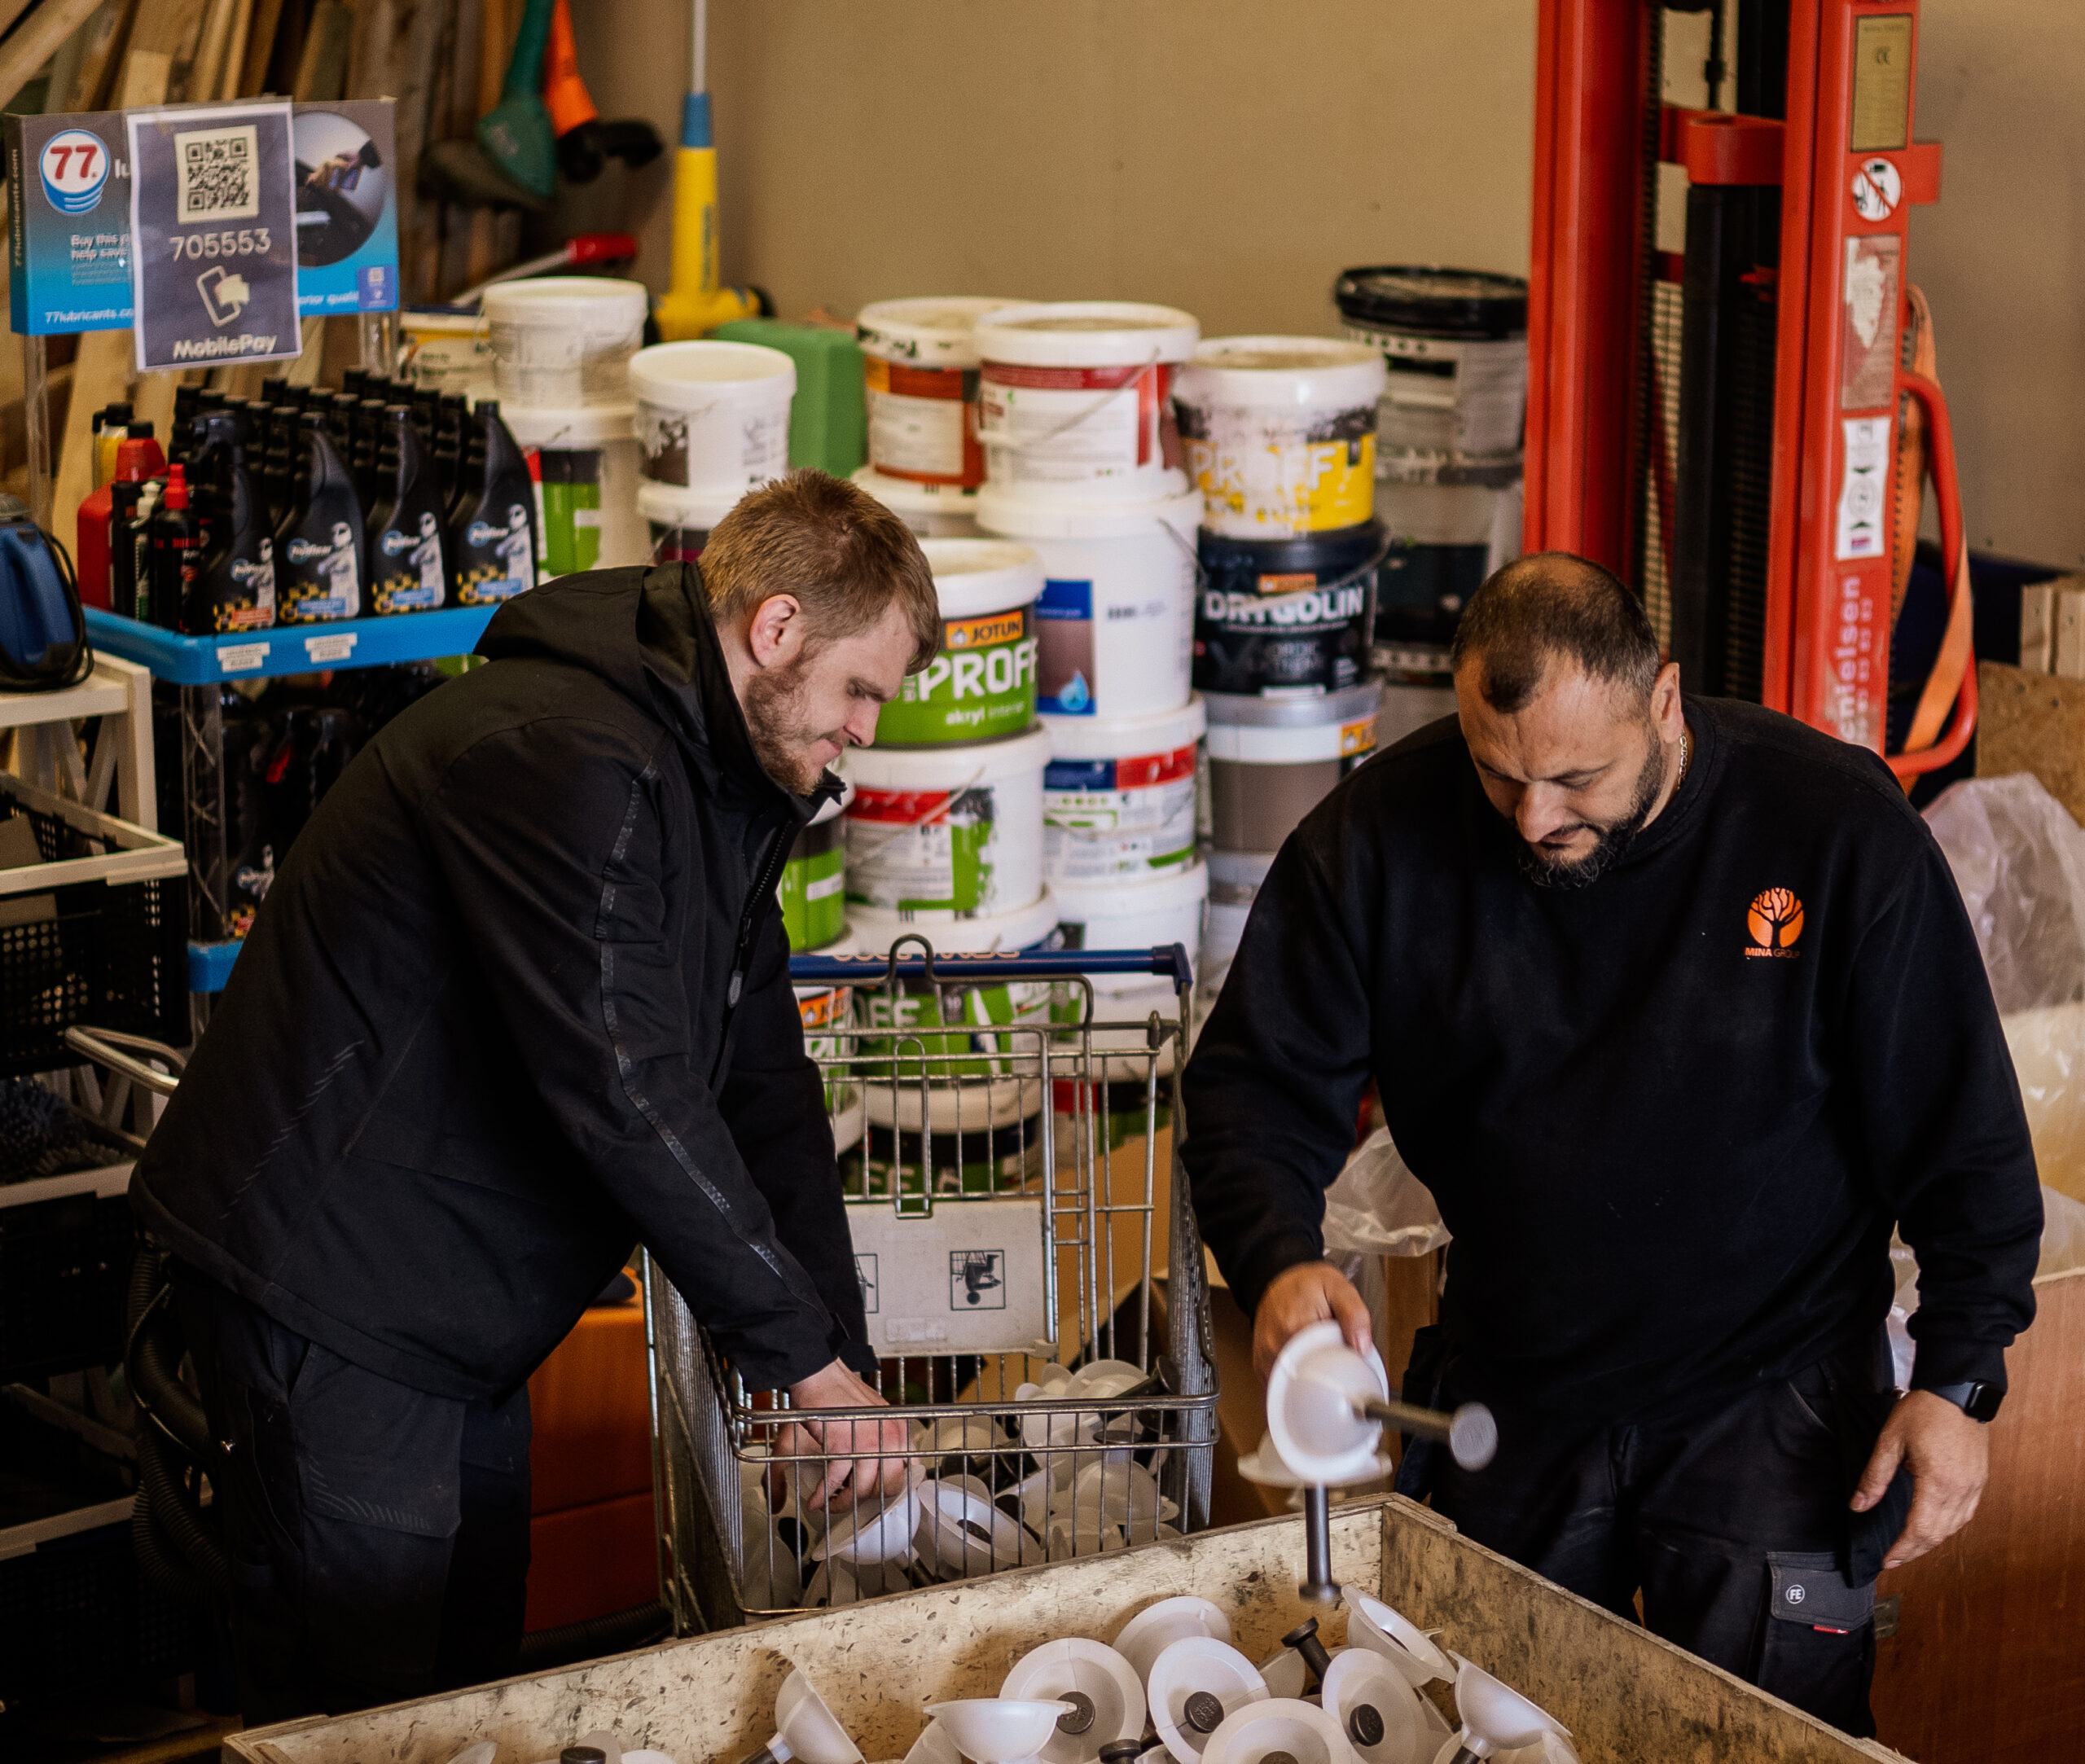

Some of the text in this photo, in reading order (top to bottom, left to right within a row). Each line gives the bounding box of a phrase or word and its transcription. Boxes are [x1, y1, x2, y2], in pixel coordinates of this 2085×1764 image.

[50, 144, 98, 180] 77
[169, 227, 271, 262] 705553
[173, 333, 278, 360] MobilePay
[972, 620, 1021, 642] JOTUN
[1745, 947, 1772, 957] MINA
[1789, 1588, 1802, 1600] FE
